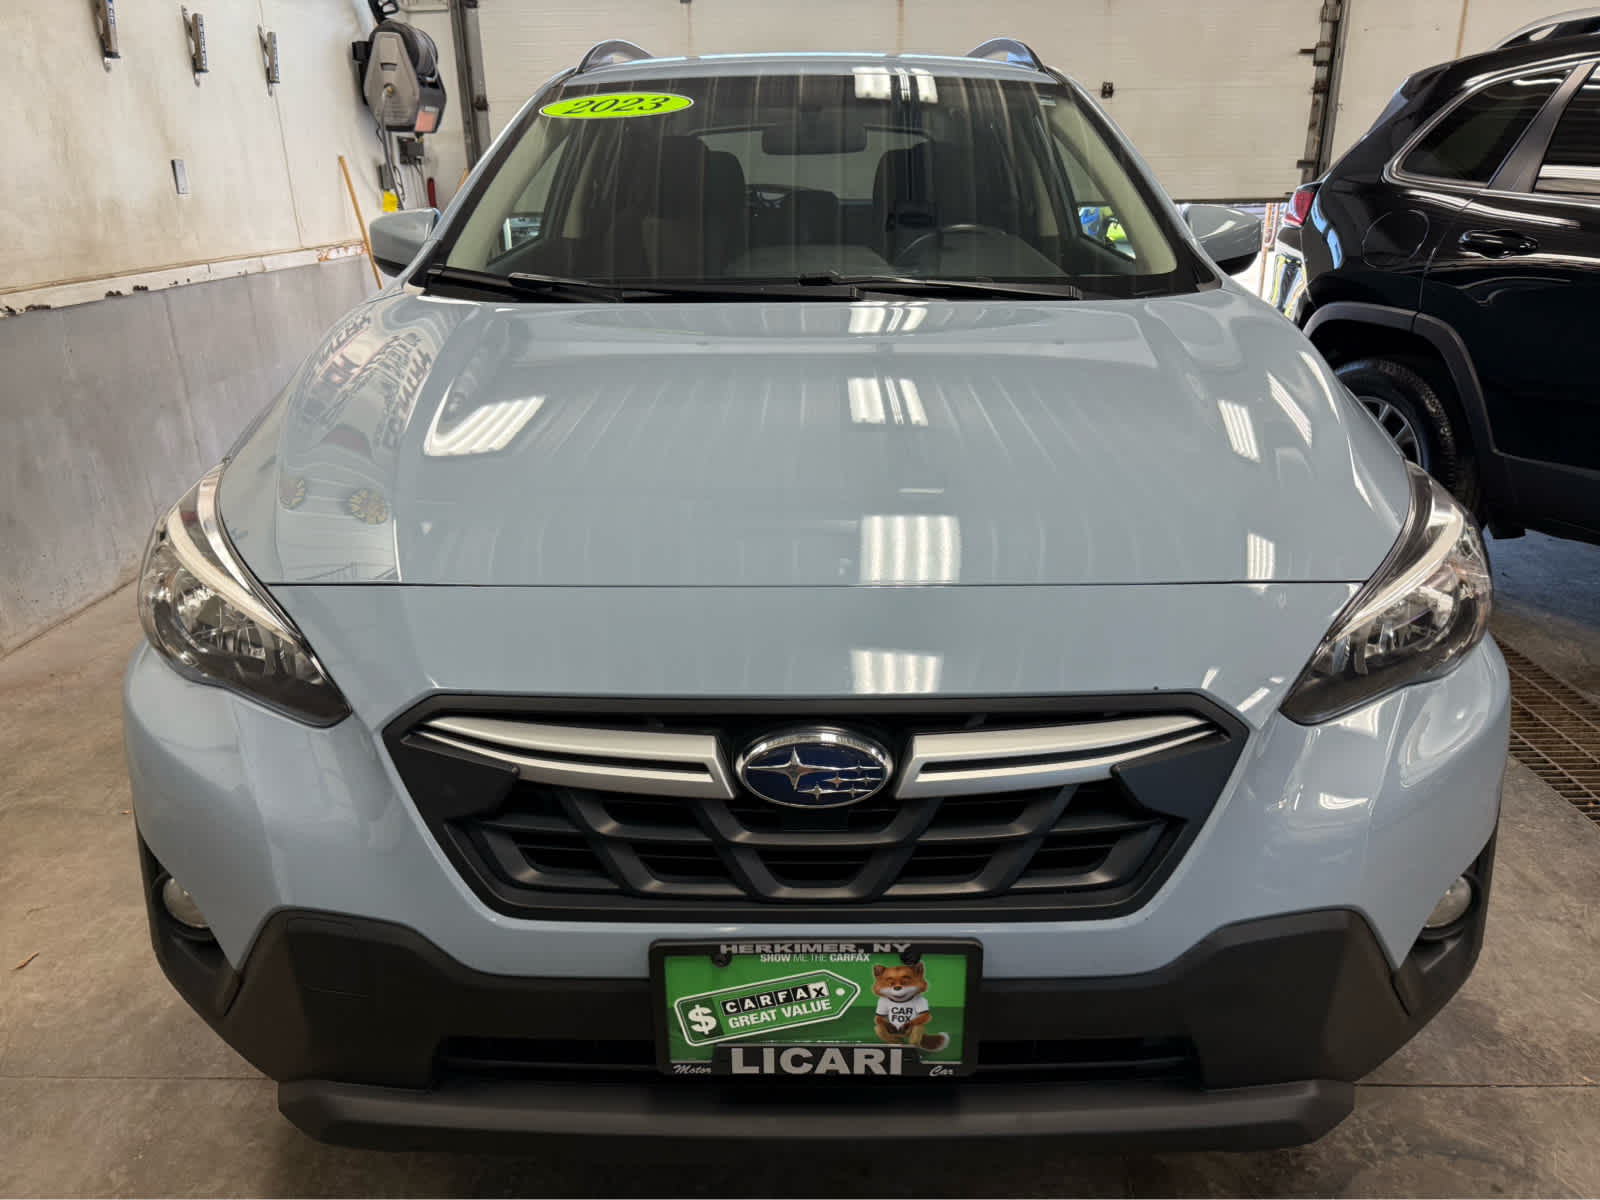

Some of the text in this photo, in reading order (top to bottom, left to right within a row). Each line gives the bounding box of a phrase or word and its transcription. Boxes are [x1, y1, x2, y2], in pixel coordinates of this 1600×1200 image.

[562, 97, 670, 114] 2023
[719, 943, 911, 955] HERKIMER, NY
[760, 953, 791, 963] SHOW
[829, 953, 871, 962] CARFAX
[724, 984, 827, 1014] CARFAX
[728, 999, 833, 1029] GREAT VALUE
[891, 1007, 914, 1015] CAR
[891, 1015, 912, 1023] FOX
[731, 1047, 903, 1075] LICARI
[673, 1064, 712, 1075] Motor
